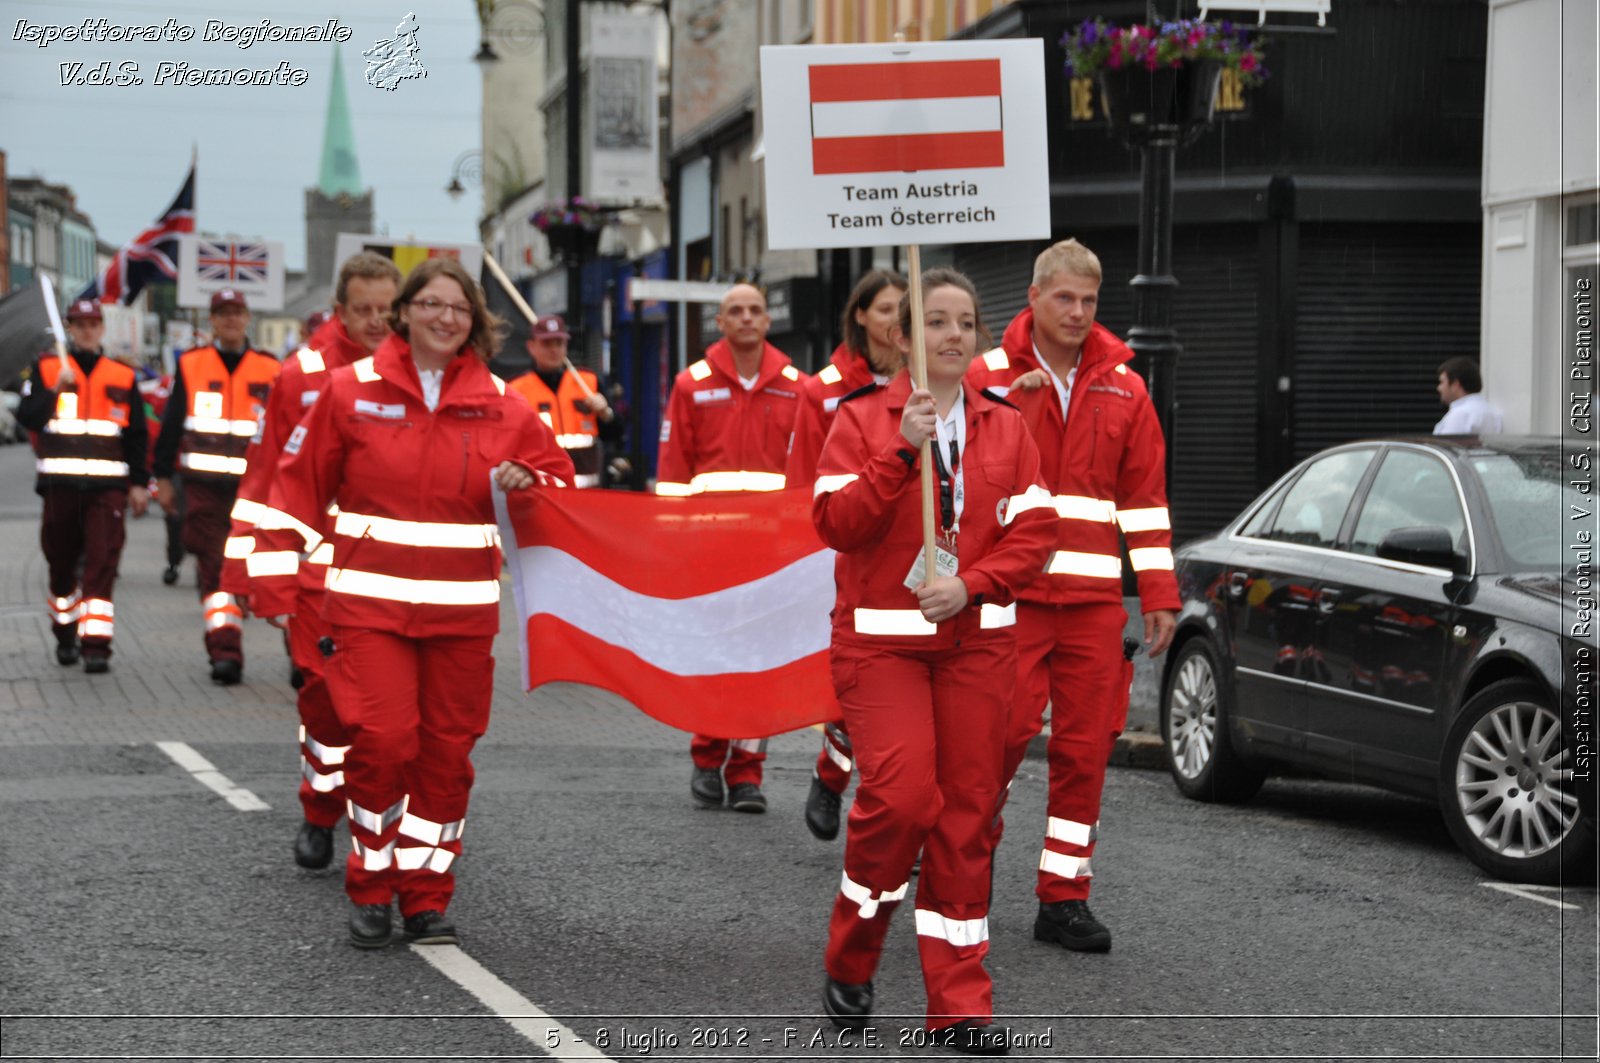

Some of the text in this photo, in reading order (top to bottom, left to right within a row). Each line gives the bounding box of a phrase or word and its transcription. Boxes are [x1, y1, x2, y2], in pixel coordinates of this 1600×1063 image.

[843, 181, 978, 201] Team Austria
[827, 206, 996, 229] Team Österreich
